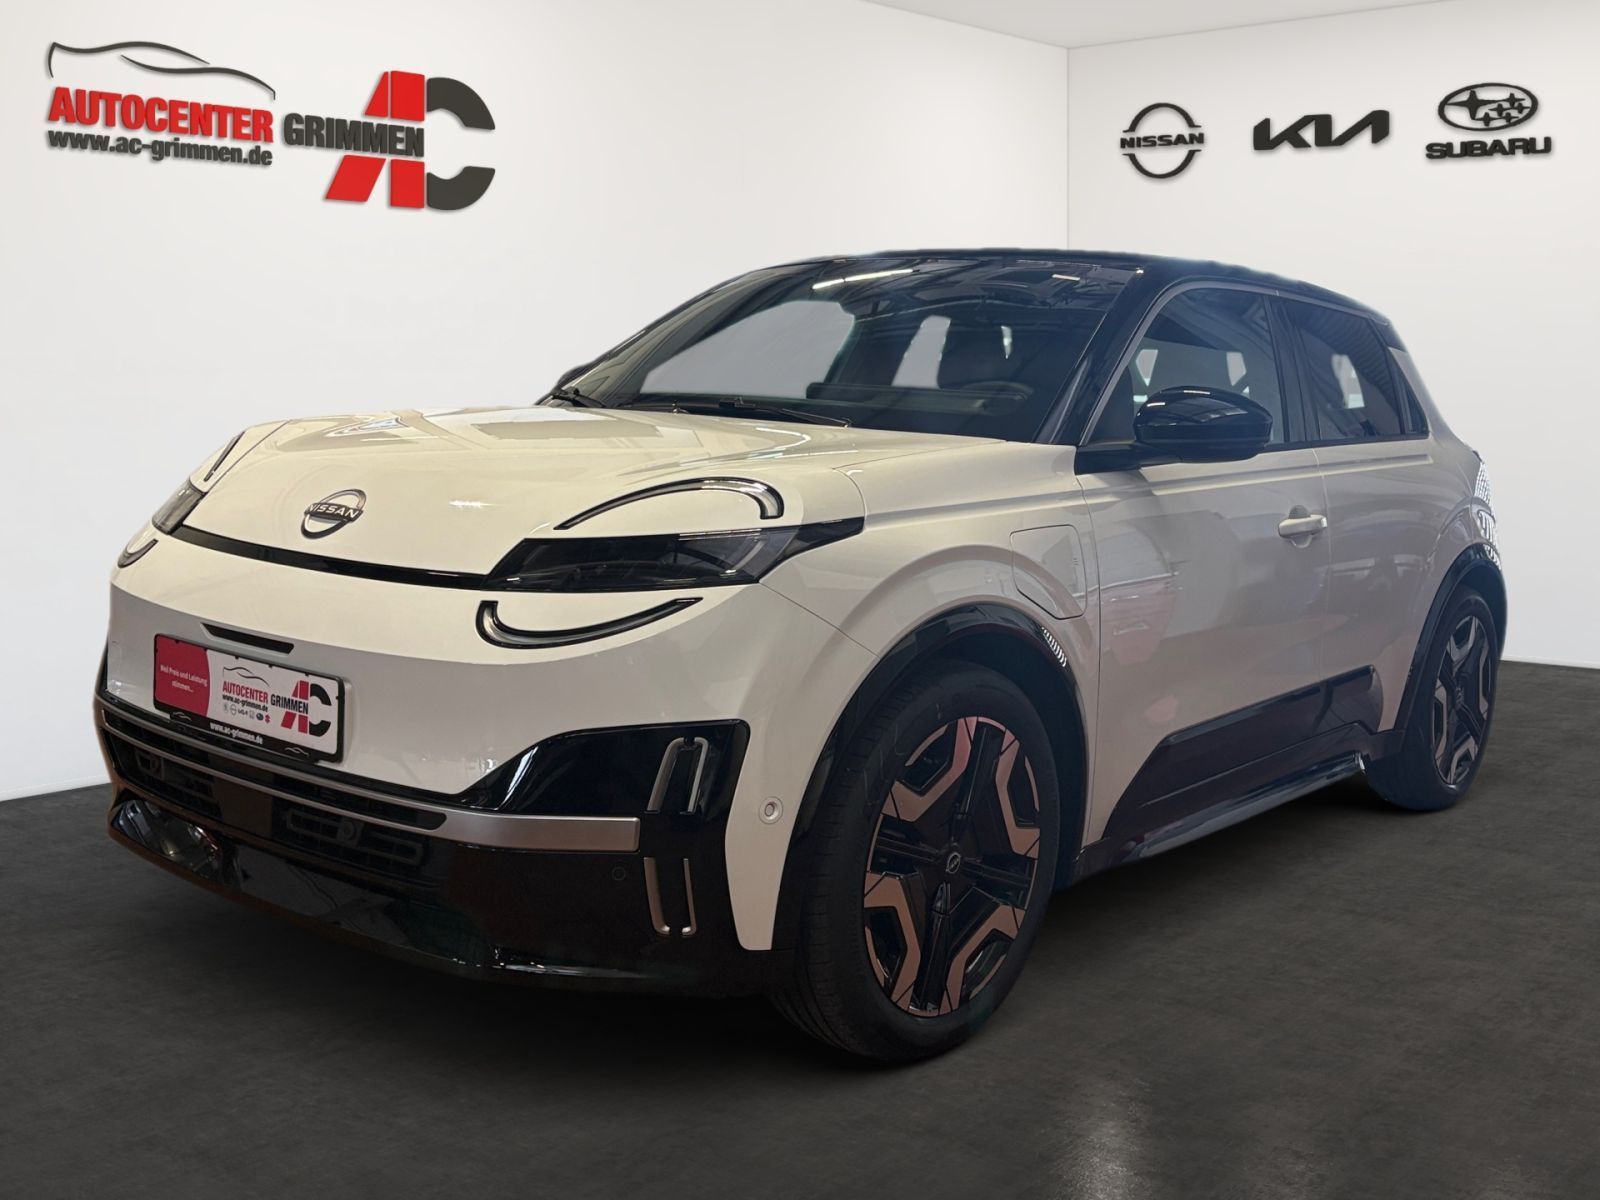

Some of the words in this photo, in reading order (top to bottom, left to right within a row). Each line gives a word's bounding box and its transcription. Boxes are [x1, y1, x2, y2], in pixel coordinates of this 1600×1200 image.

[48, 86, 273, 142] AUTOCENTER
[284, 113, 425, 157] GRIMMEN
[1253, 110, 1390, 151] KIA
[48, 130, 273, 165] www.ac-grimmen.de
[1120, 132, 1204, 149] NISSAN
[1425, 137, 1552, 160] SUBARU
[309, 503, 360, 519] NISSAN
[222, 681, 269, 703] AUTOCENTER
[270, 694, 309, 715] GRIMMEN
[222, 694, 269, 713] www.ac-grimmen.de
[210, 722, 263, 745] www.ac-grimmen.de
